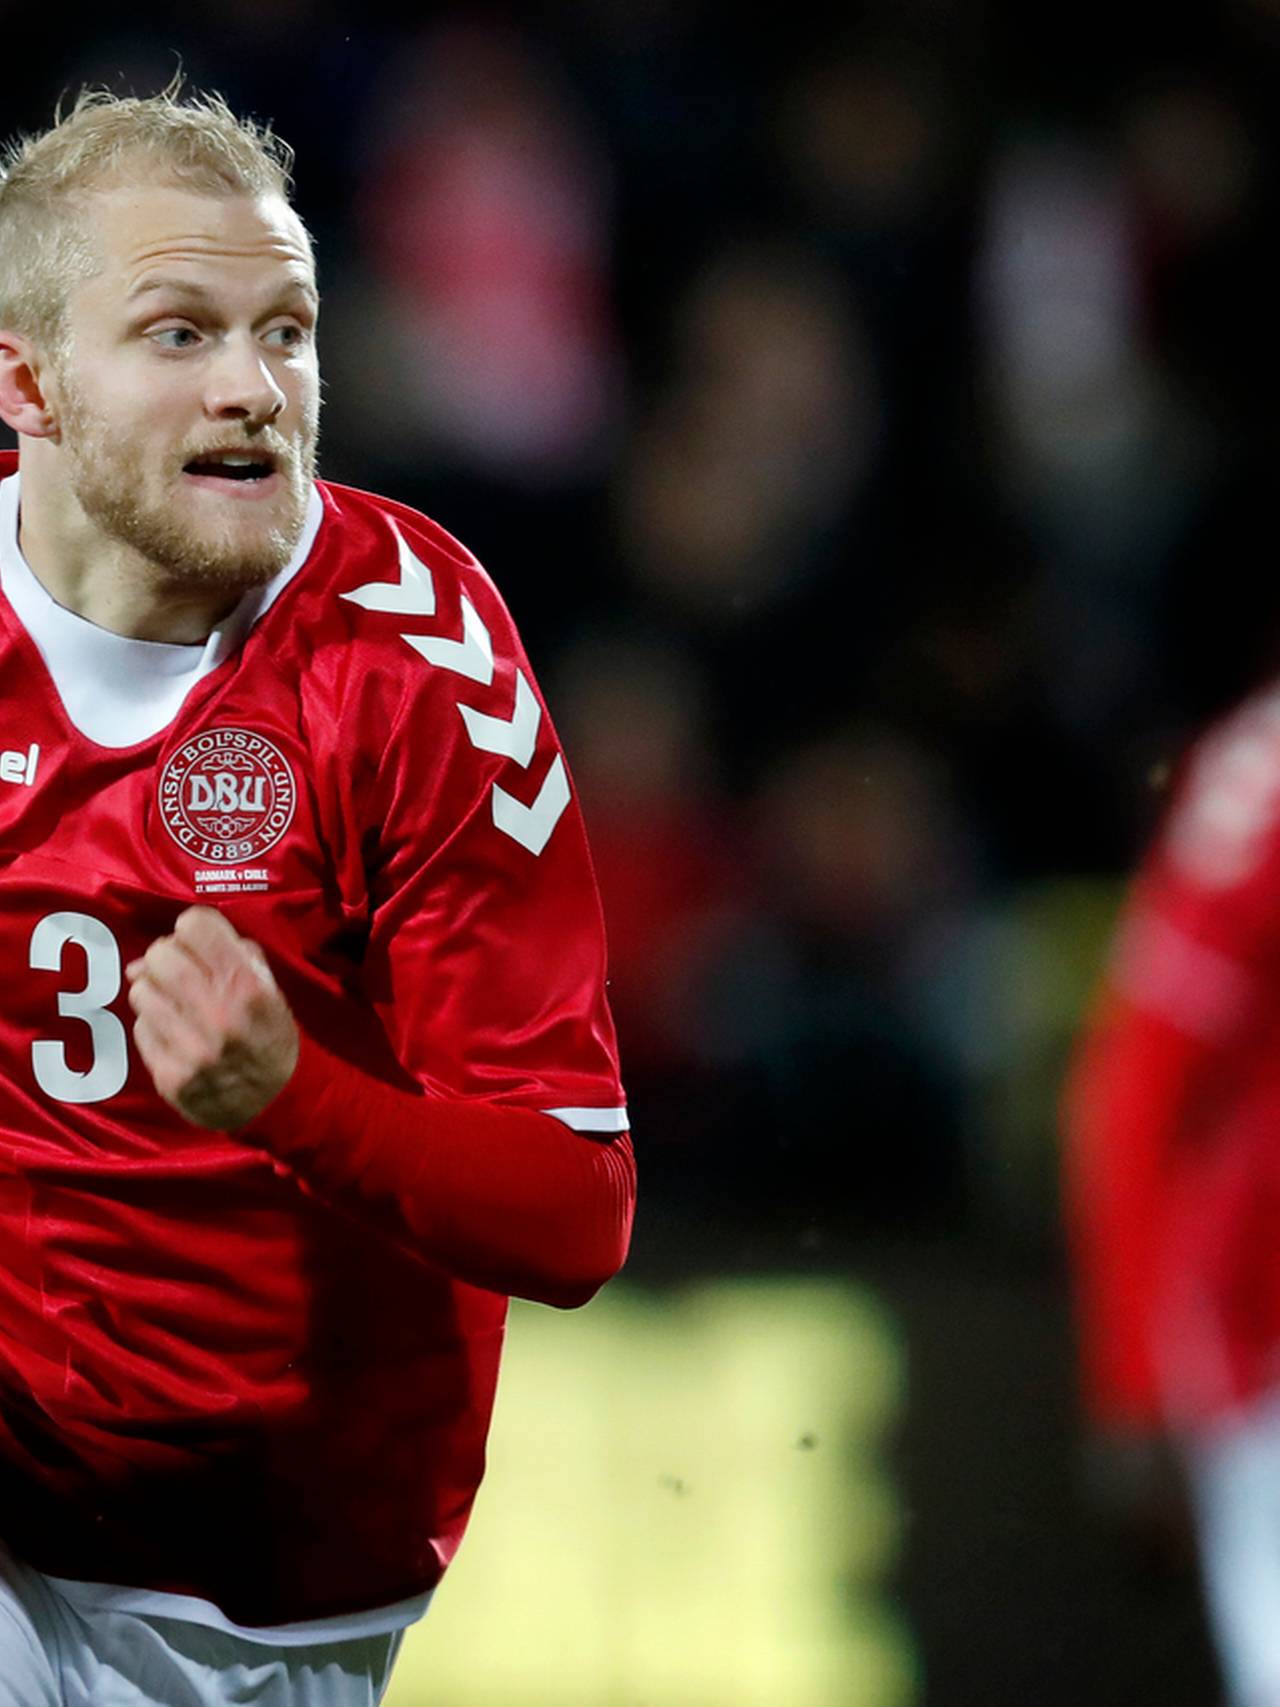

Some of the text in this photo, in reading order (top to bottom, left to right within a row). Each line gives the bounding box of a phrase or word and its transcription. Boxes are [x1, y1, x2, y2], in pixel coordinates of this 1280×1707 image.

[164, 765, 195, 845] DANSK
[187, 772, 267, 813] DBU
[200, 841, 253, 859] 1889
[29, 912, 129, 1104] 3
